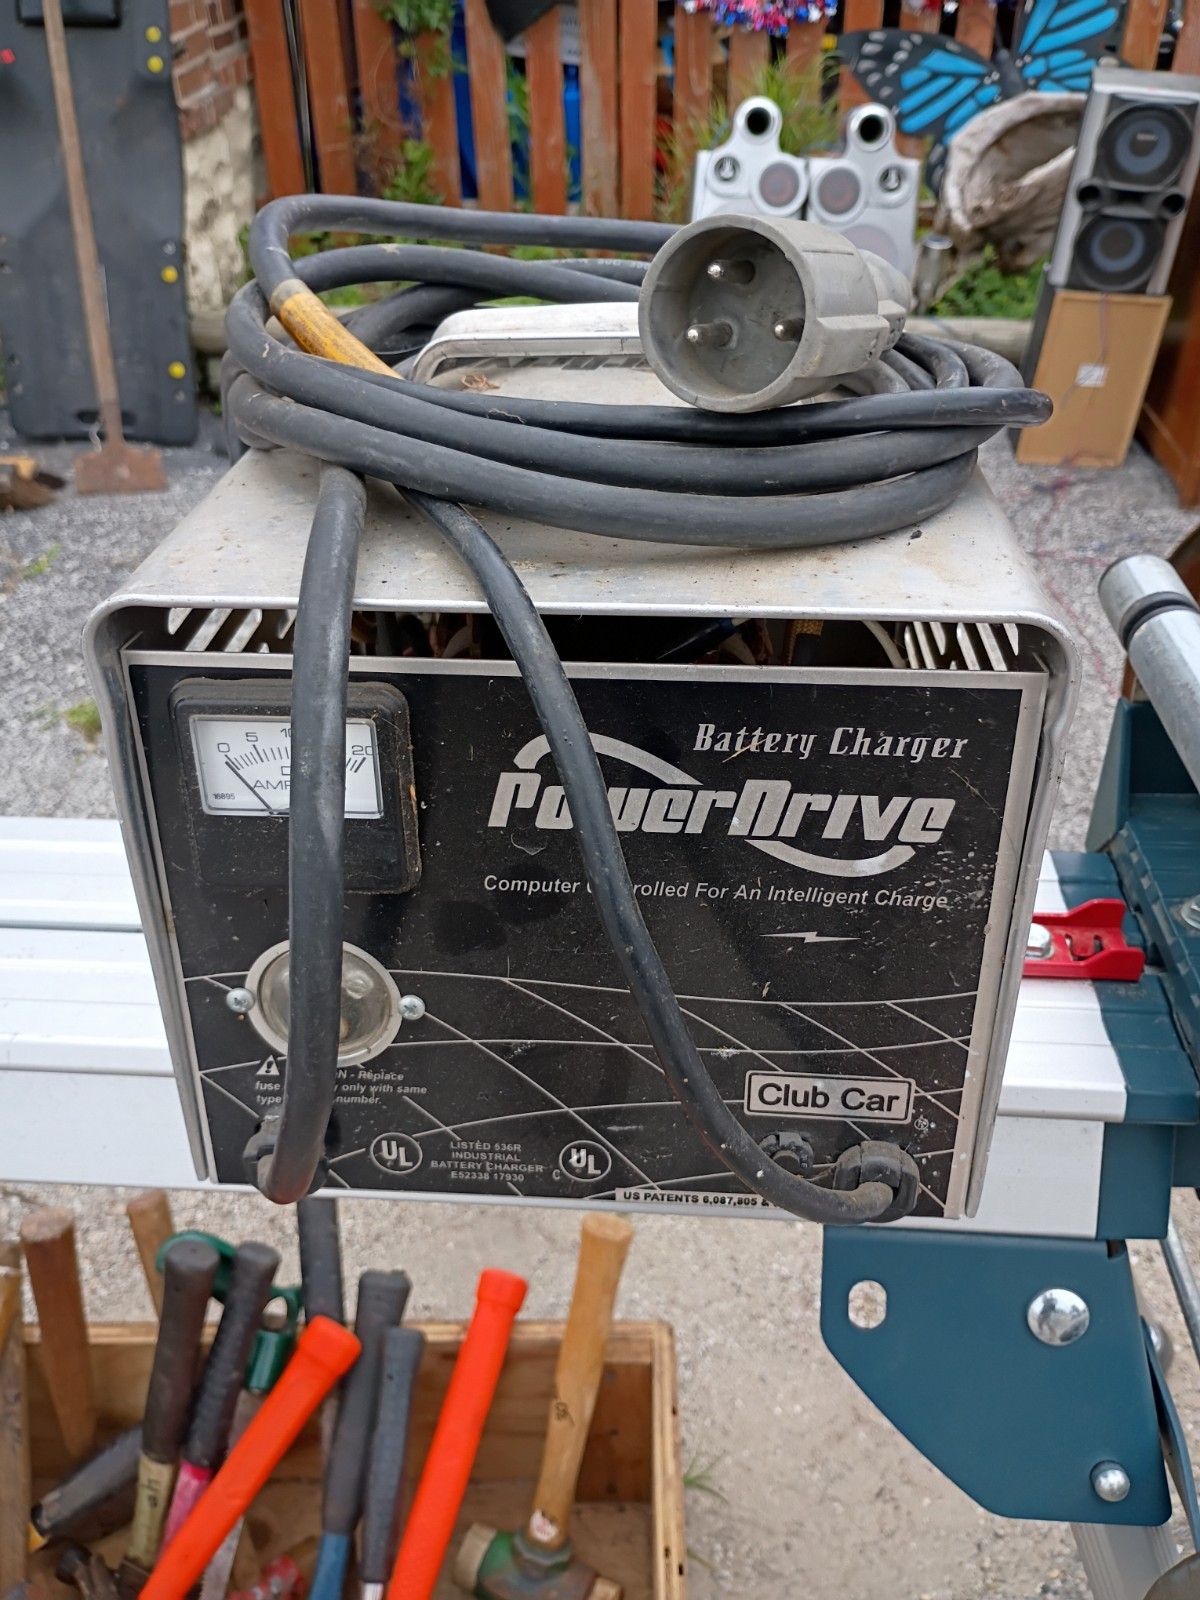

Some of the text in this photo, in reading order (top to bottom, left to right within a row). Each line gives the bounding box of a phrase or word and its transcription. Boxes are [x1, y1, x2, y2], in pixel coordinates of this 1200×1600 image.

[245, 732, 258, 742] 5
[217, 743, 230, 753] 0
[693, 723, 969, 763] Battery Charger
[484, 875, 948, 912] Computer rolled For An Intelligent Charge
[358, 1070, 404, 1082] Replace
[255, 1081, 281, 1090] fuse
[342, 1083, 366, 1093] only
[370, 1083, 393, 1093] with
[397, 1086, 427, 1094] same
[256, 1095, 282, 1104] type
[758, 1082, 900, 1112] Club Car
[450, 1141, 522, 1152] LISTED 536R
[381, 1140, 413, 1166] UL
[452, 1151, 521, 1162] INDUSTRIAL
[430, 1160, 543, 1172] BATTERY CHARGER
[570, 1148, 602, 1175] UL
[450, 1171, 525, 1181] E52338 17930
[623, 1191, 640, 1200] US
[644, 1193, 699, 1203] PATENTS
